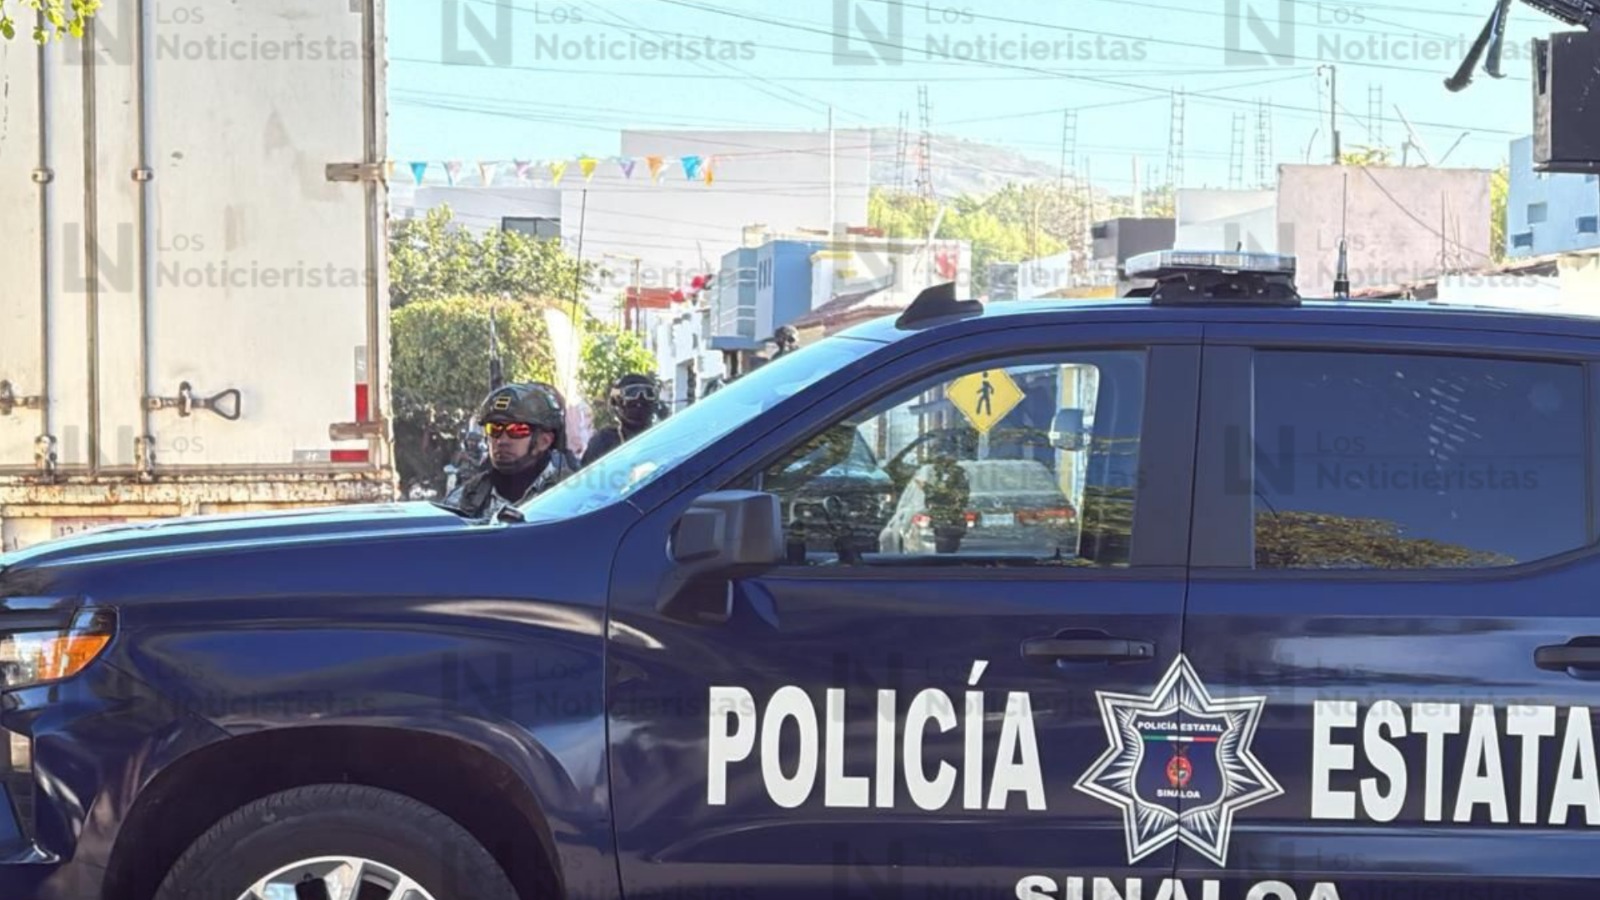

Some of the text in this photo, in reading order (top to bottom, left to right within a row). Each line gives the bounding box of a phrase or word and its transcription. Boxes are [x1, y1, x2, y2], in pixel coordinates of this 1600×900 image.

[708, 660, 1047, 811] POLICÍA
[1137, 721, 1223, 732] POLICÍA ESTATAL
